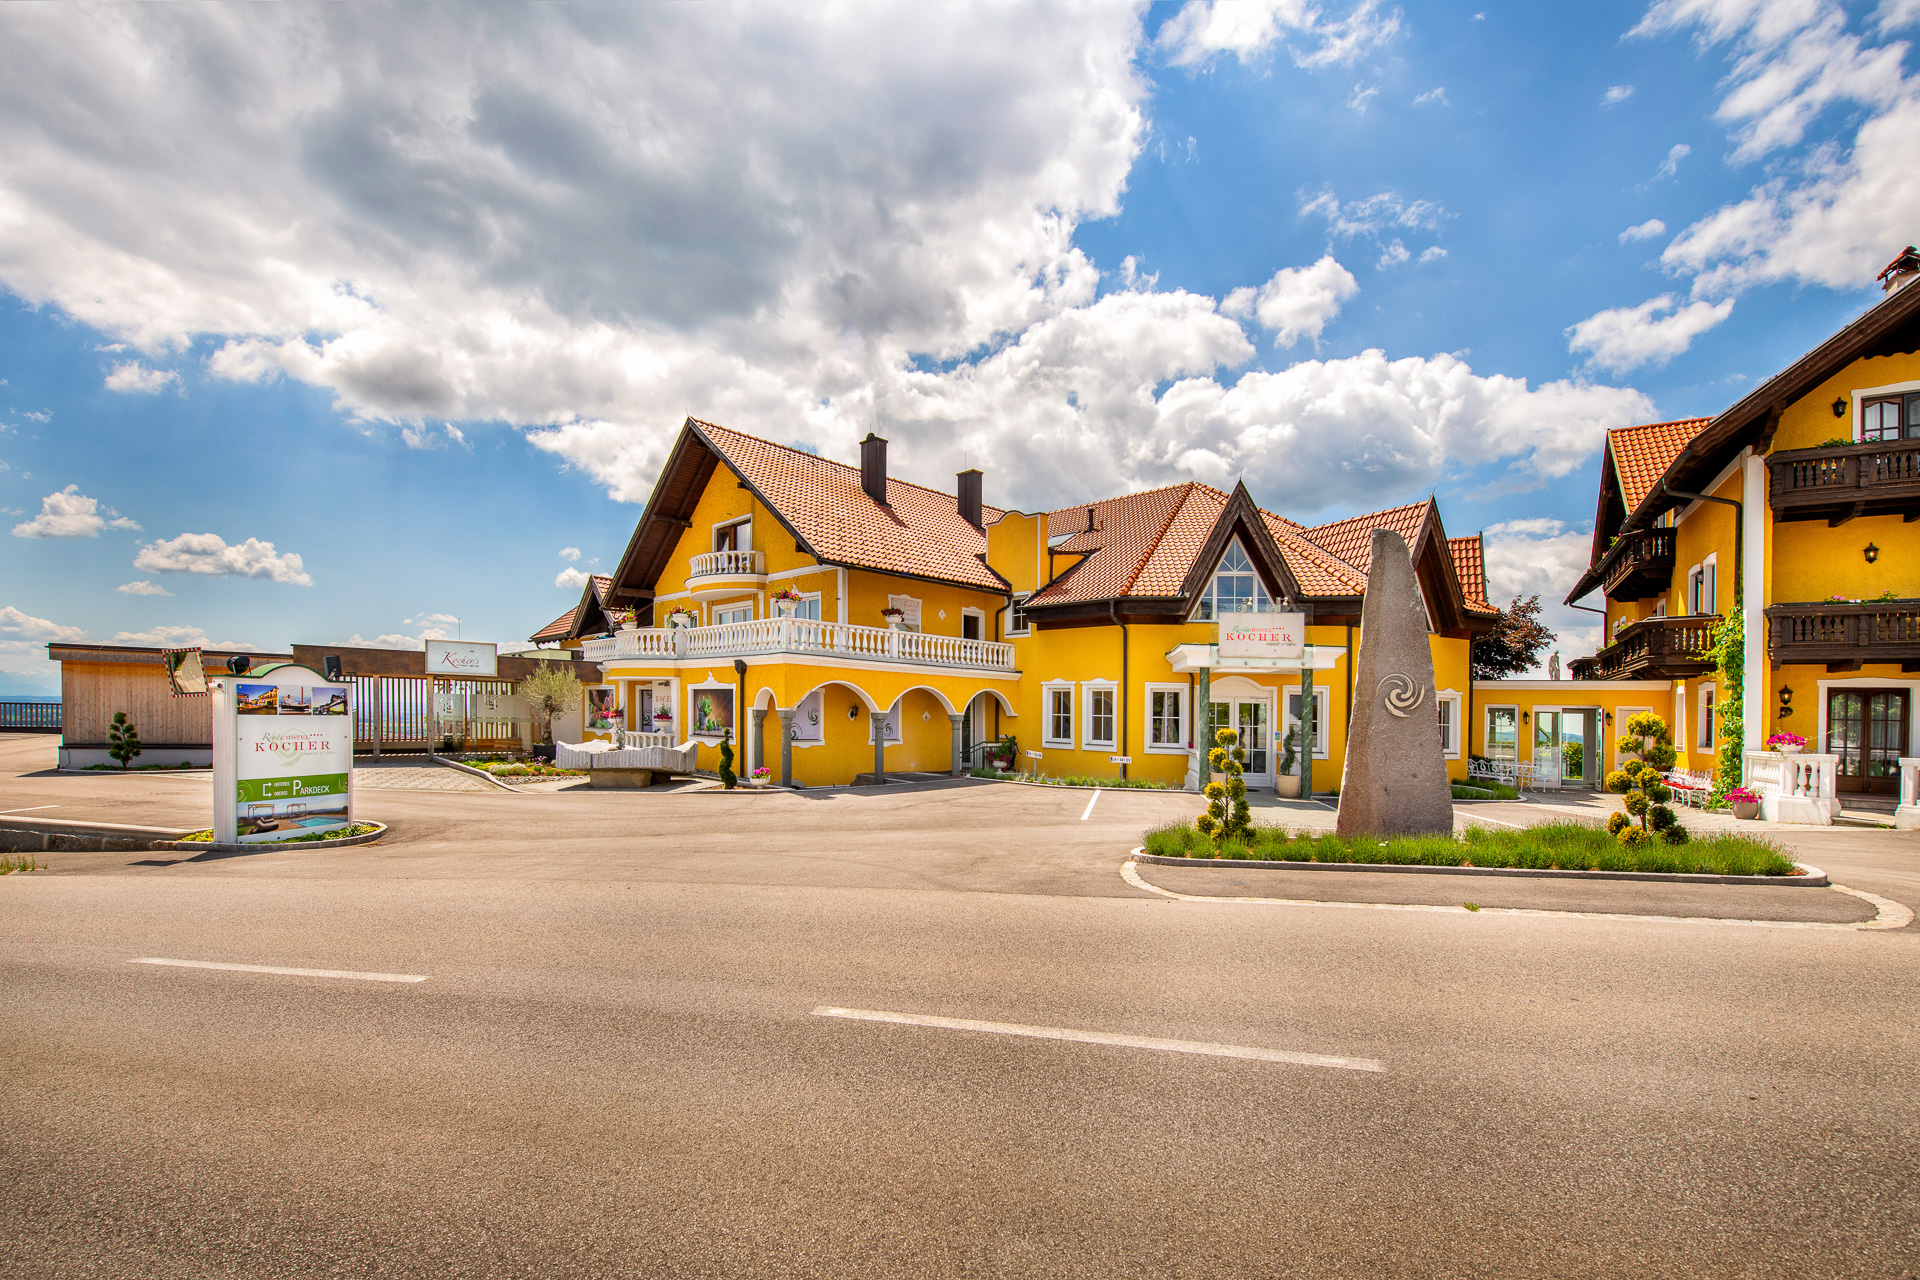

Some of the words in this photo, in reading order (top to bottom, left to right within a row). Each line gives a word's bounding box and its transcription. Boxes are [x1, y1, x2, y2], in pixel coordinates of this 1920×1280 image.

[1226, 633, 1291, 641] KOCHER
[442, 650, 480, 668] Kocher's
[255, 741, 330, 752] KOCHER
